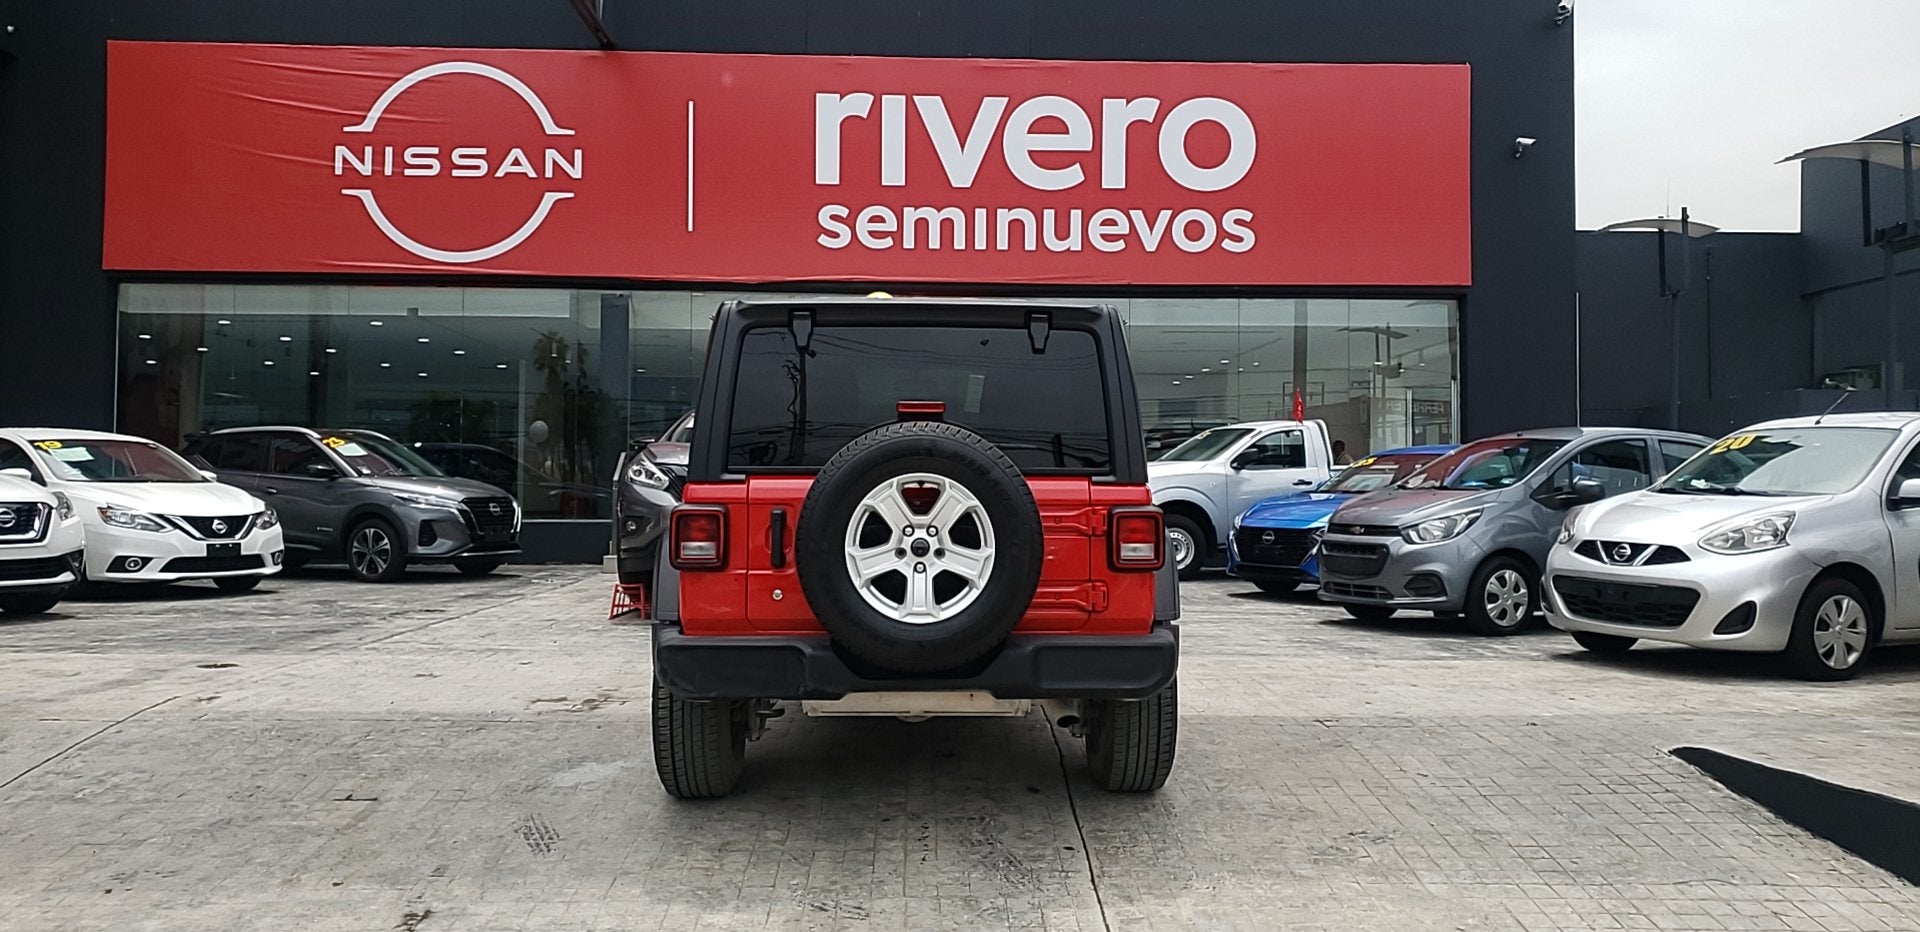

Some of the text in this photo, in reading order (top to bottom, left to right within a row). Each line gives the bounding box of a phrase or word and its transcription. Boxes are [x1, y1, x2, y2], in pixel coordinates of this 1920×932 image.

[815, 92, 1257, 193] rivero
[334, 145, 584, 179] NISSAN
[816, 204, 1257, 254] seminuevos
[33, 440, 63, 451] 19
[1708, 434, 1757, 456] 20
